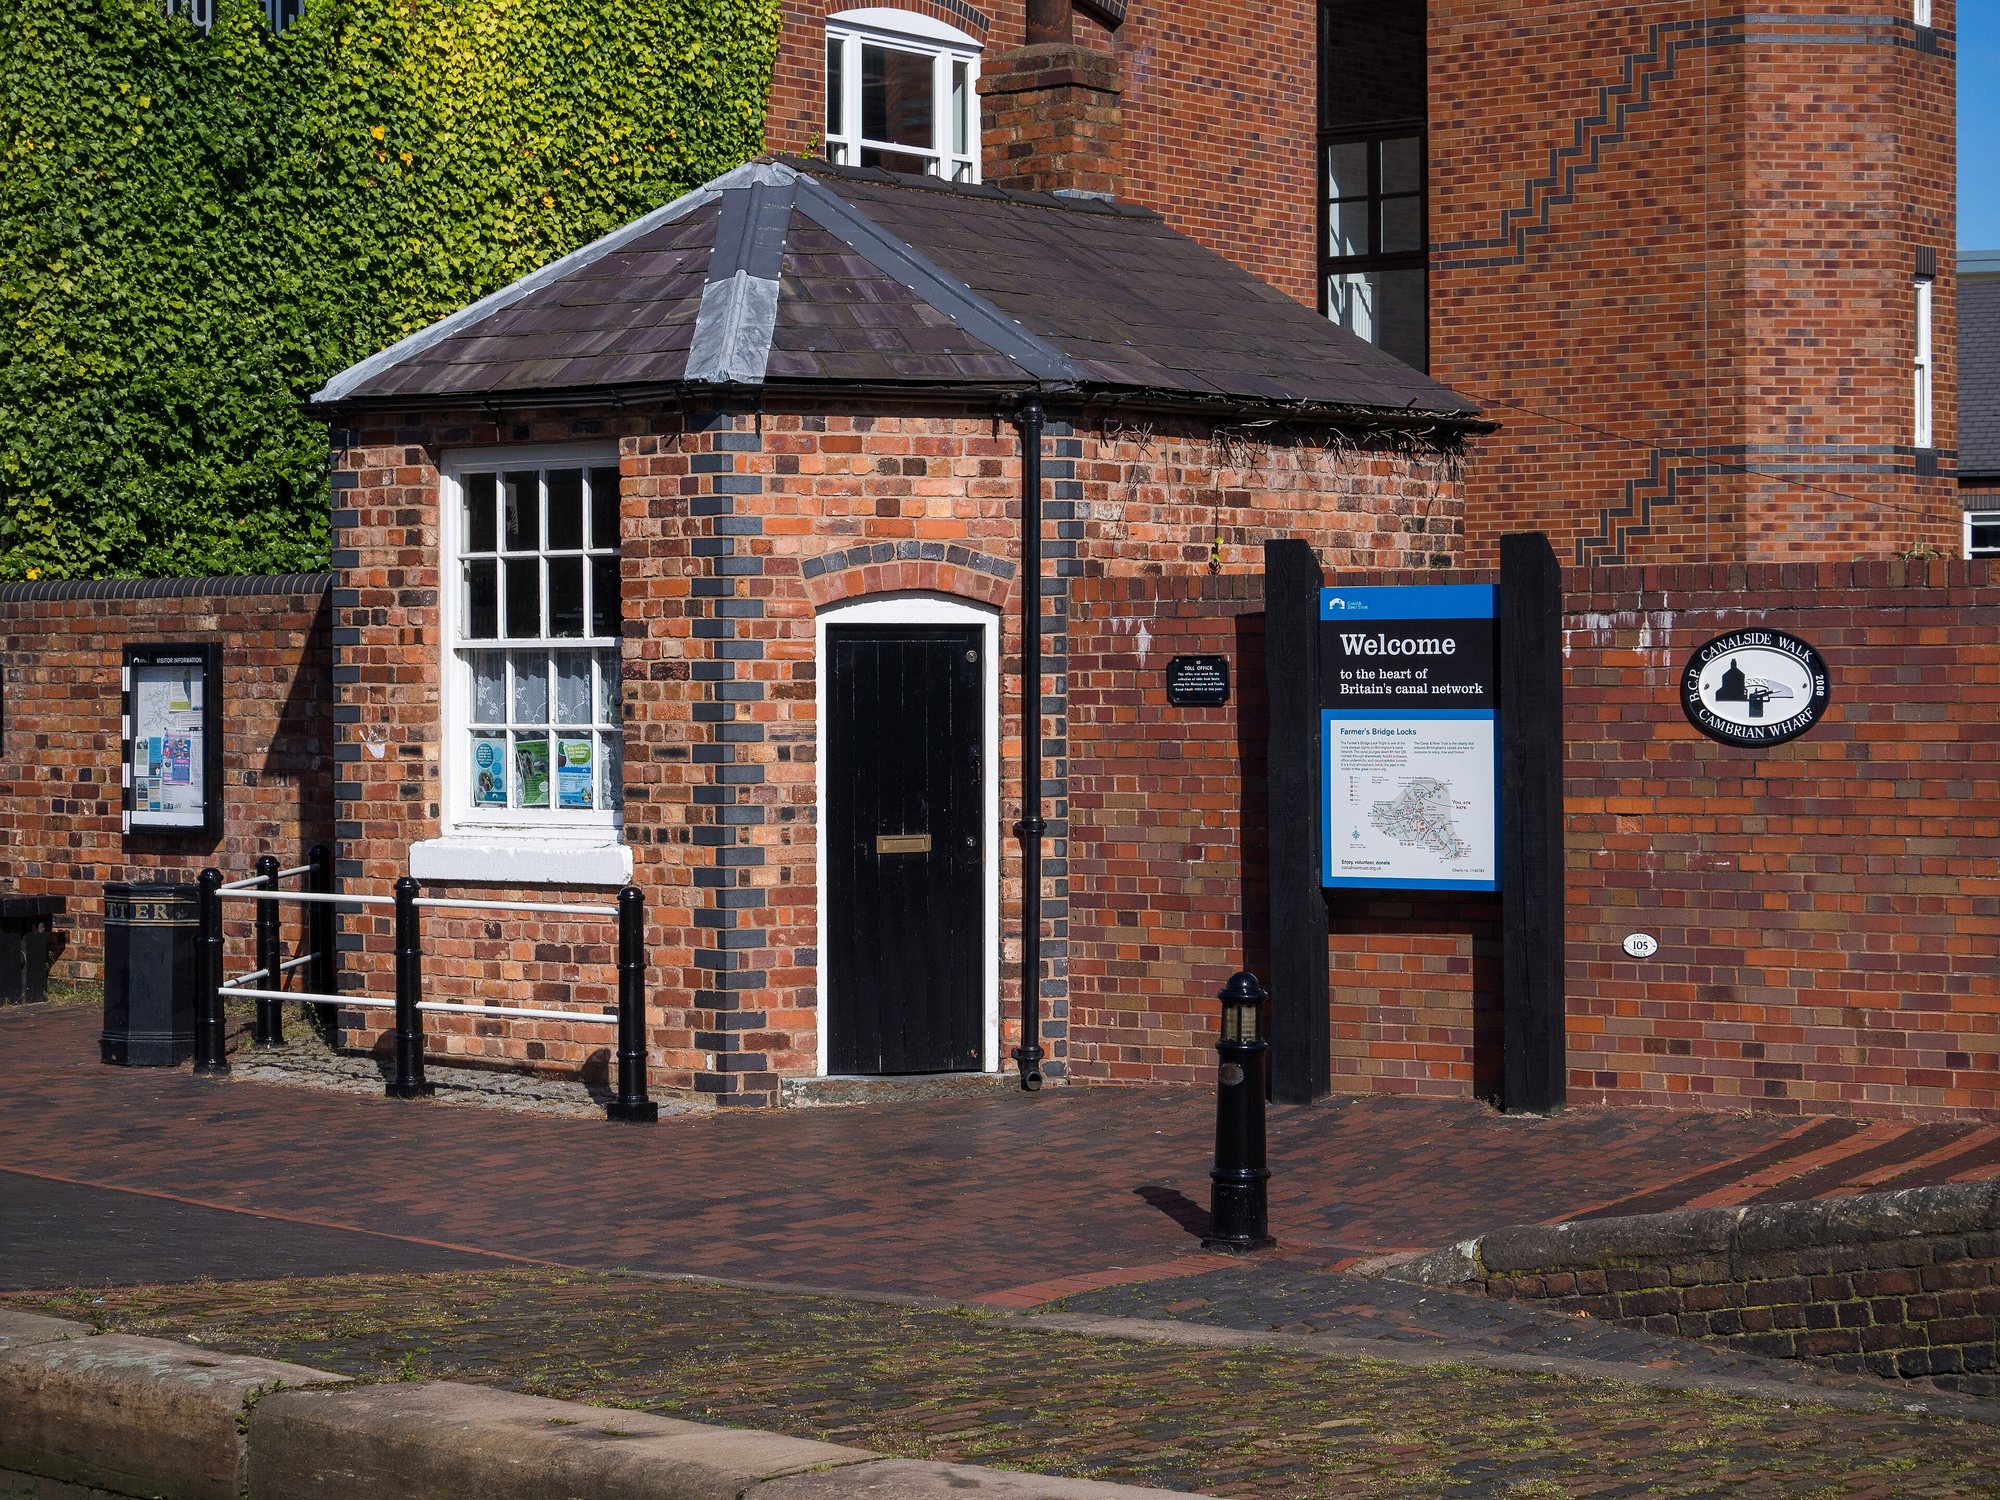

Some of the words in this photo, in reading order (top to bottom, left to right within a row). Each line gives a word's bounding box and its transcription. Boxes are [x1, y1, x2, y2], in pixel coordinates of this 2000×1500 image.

[1340, 634, 1456, 656] Welcome
[1701, 632, 1772, 662] CANALSIDE
[1779, 636, 1813, 663] WALK
[1340, 669, 1352, 679] to
[1356, 668, 1375, 679] the
[1379, 668, 1411, 679] heart
[1415, 668, 1428, 679] of
[1340, 683, 1392, 694] Britain's
[1395, 683, 1428, 694] canal
[1432, 683, 1483, 694] network
[1687, 669, 1700, 702] B.C.P.
[1816, 675, 1824, 696] 2008
[1372, 728, 1395, 736] Bridge
[1699, 709, 1765, 738] CAMBRIAN
[1768, 708, 1813, 737] WHARF
[1633, 940, 1648, 950] 105
